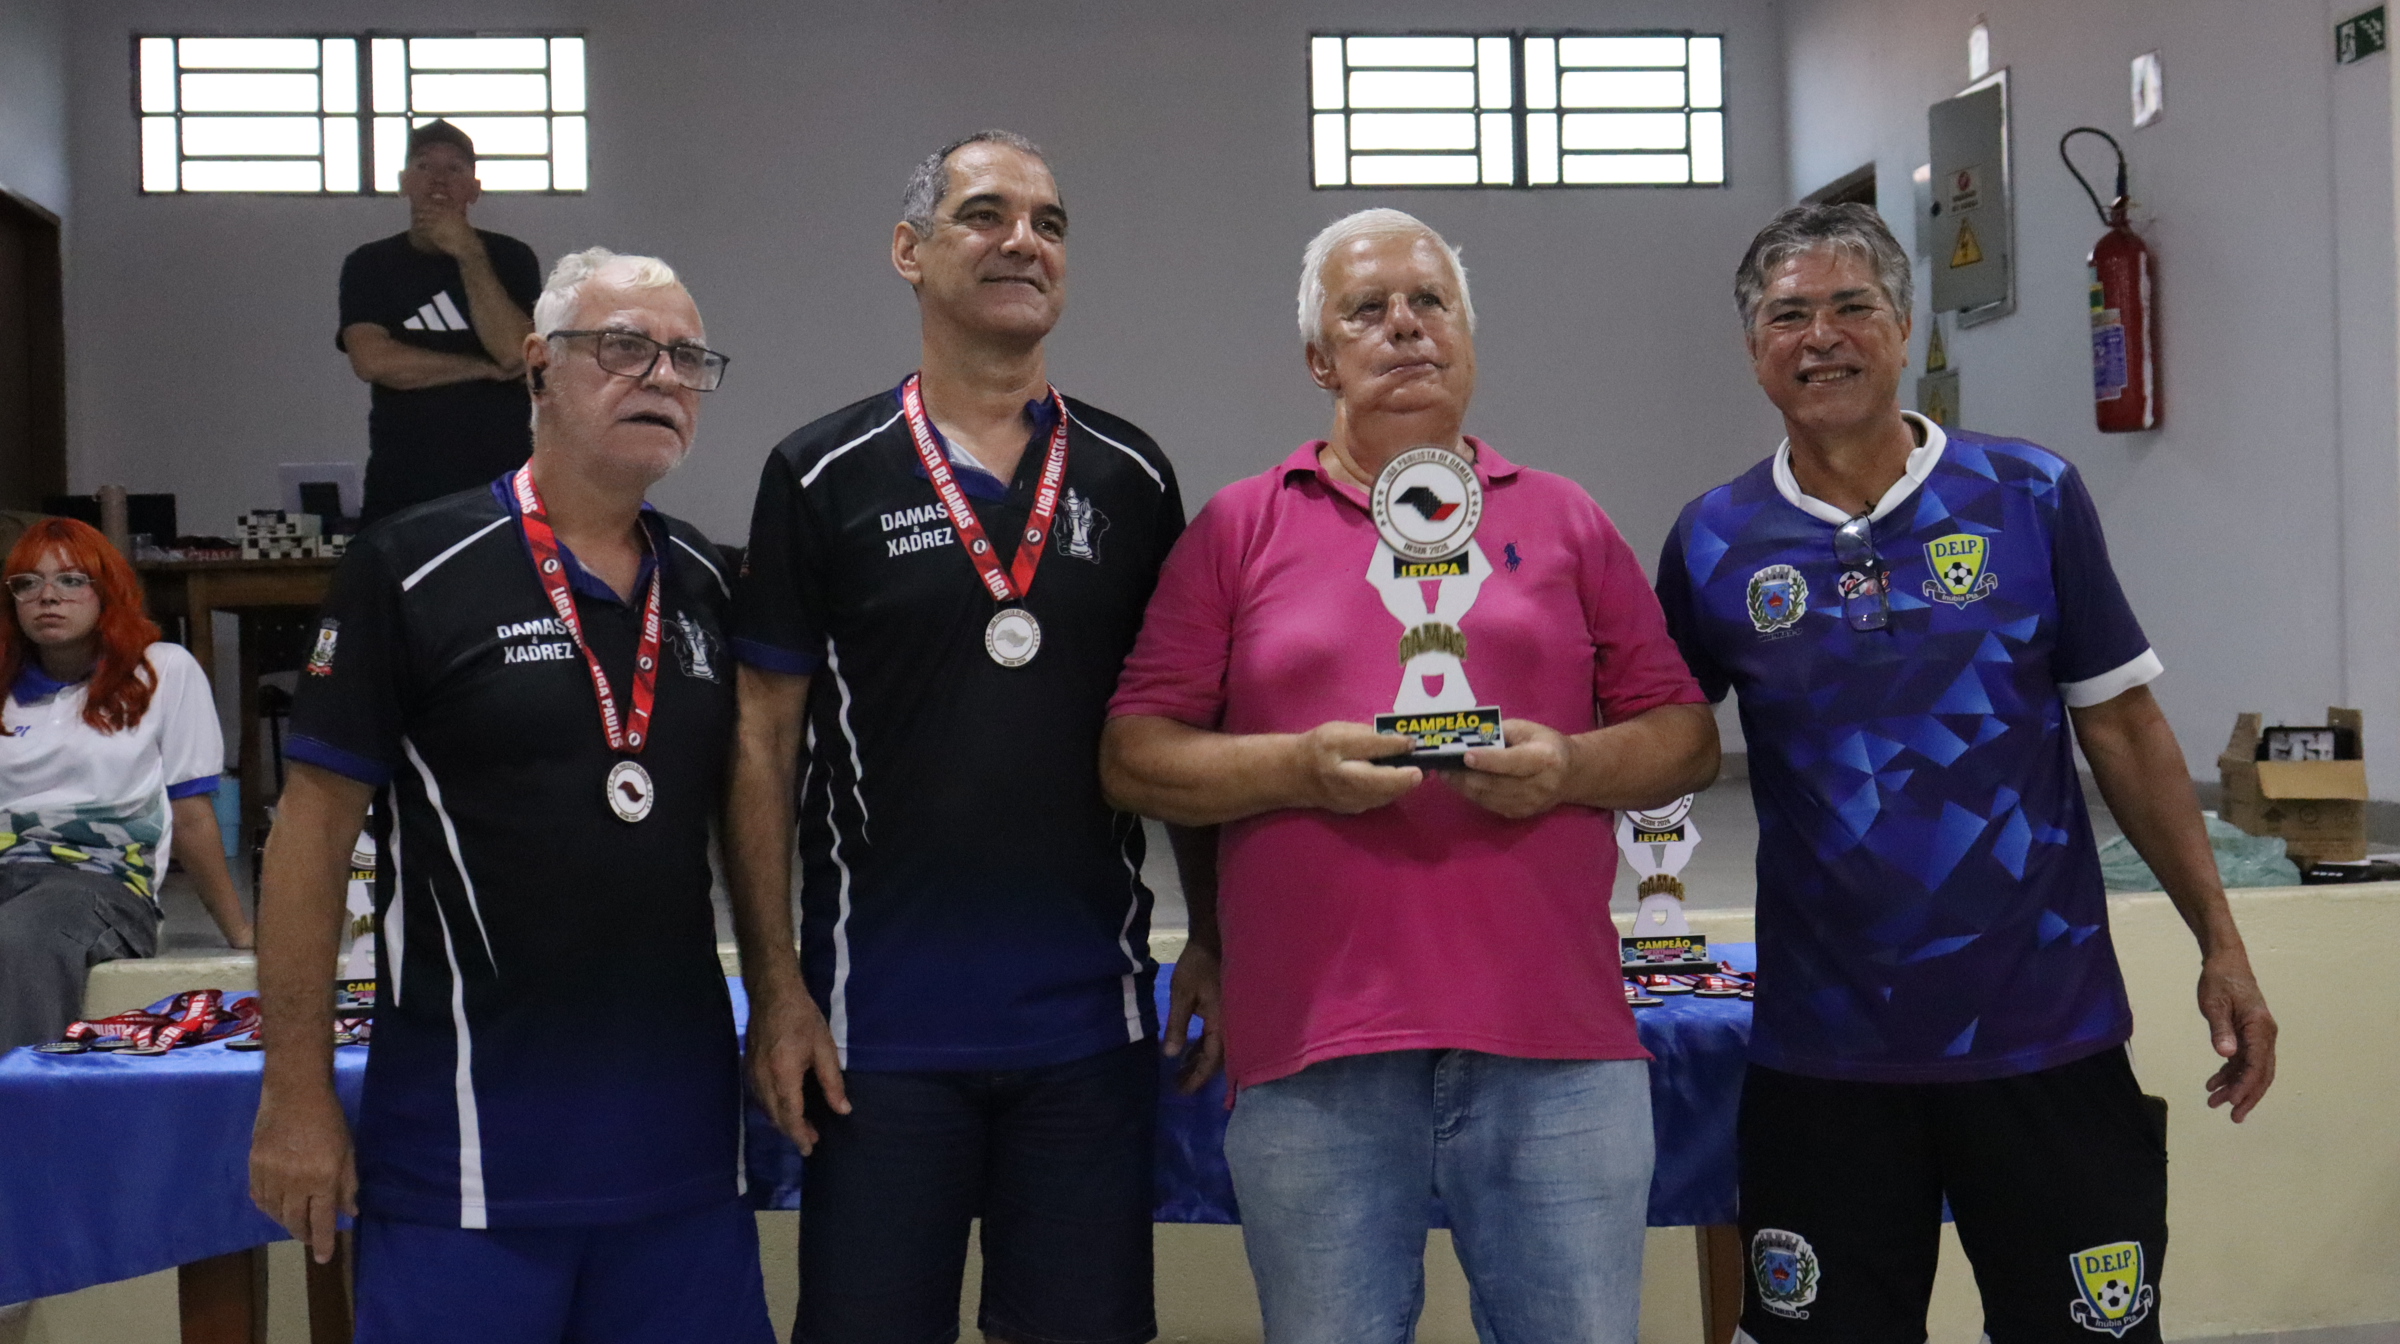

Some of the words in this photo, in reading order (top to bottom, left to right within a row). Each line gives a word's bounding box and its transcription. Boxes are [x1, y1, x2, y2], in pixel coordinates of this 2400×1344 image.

[911, 414, 943, 469] PAULISTA
[932, 466, 952, 486] DE
[1043, 437, 1067, 488] PAULISTA
[1450, 456, 1475, 484] DAMAS
[515, 472, 539, 514] DAMAS
[941, 483, 976, 530] DAMAS
[1035, 487, 1057, 517] LIGA
[880, 502, 949, 532] DAMAS
[913, 525, 920, 533] &
[886, 527, 954, 557] XADREZ
[1935, 539, 1980, 558] D.E.I.P.
[984, 568, 1010, 600] LIGA
[1409, 562, 1460, 577] ETAPA
[551, 586, 572, 619] LIGA
[497, 617, 567, 639] DAMAS
[644, 613, 659, 643] LIGA
[504, 642, 575, 665] XADREZ
[592, 665, 610, 697] LIGA
[601, 698, 624, 748] PAULIS
[1396, 712, 1480, 733] CAMPEÃO
[1643, 832, 1679, 842] ETAPA
[1636, 937, 1691, 951] CAMPEÃO
[2085, 1249, 2136, 1274] D.E.I.P.
